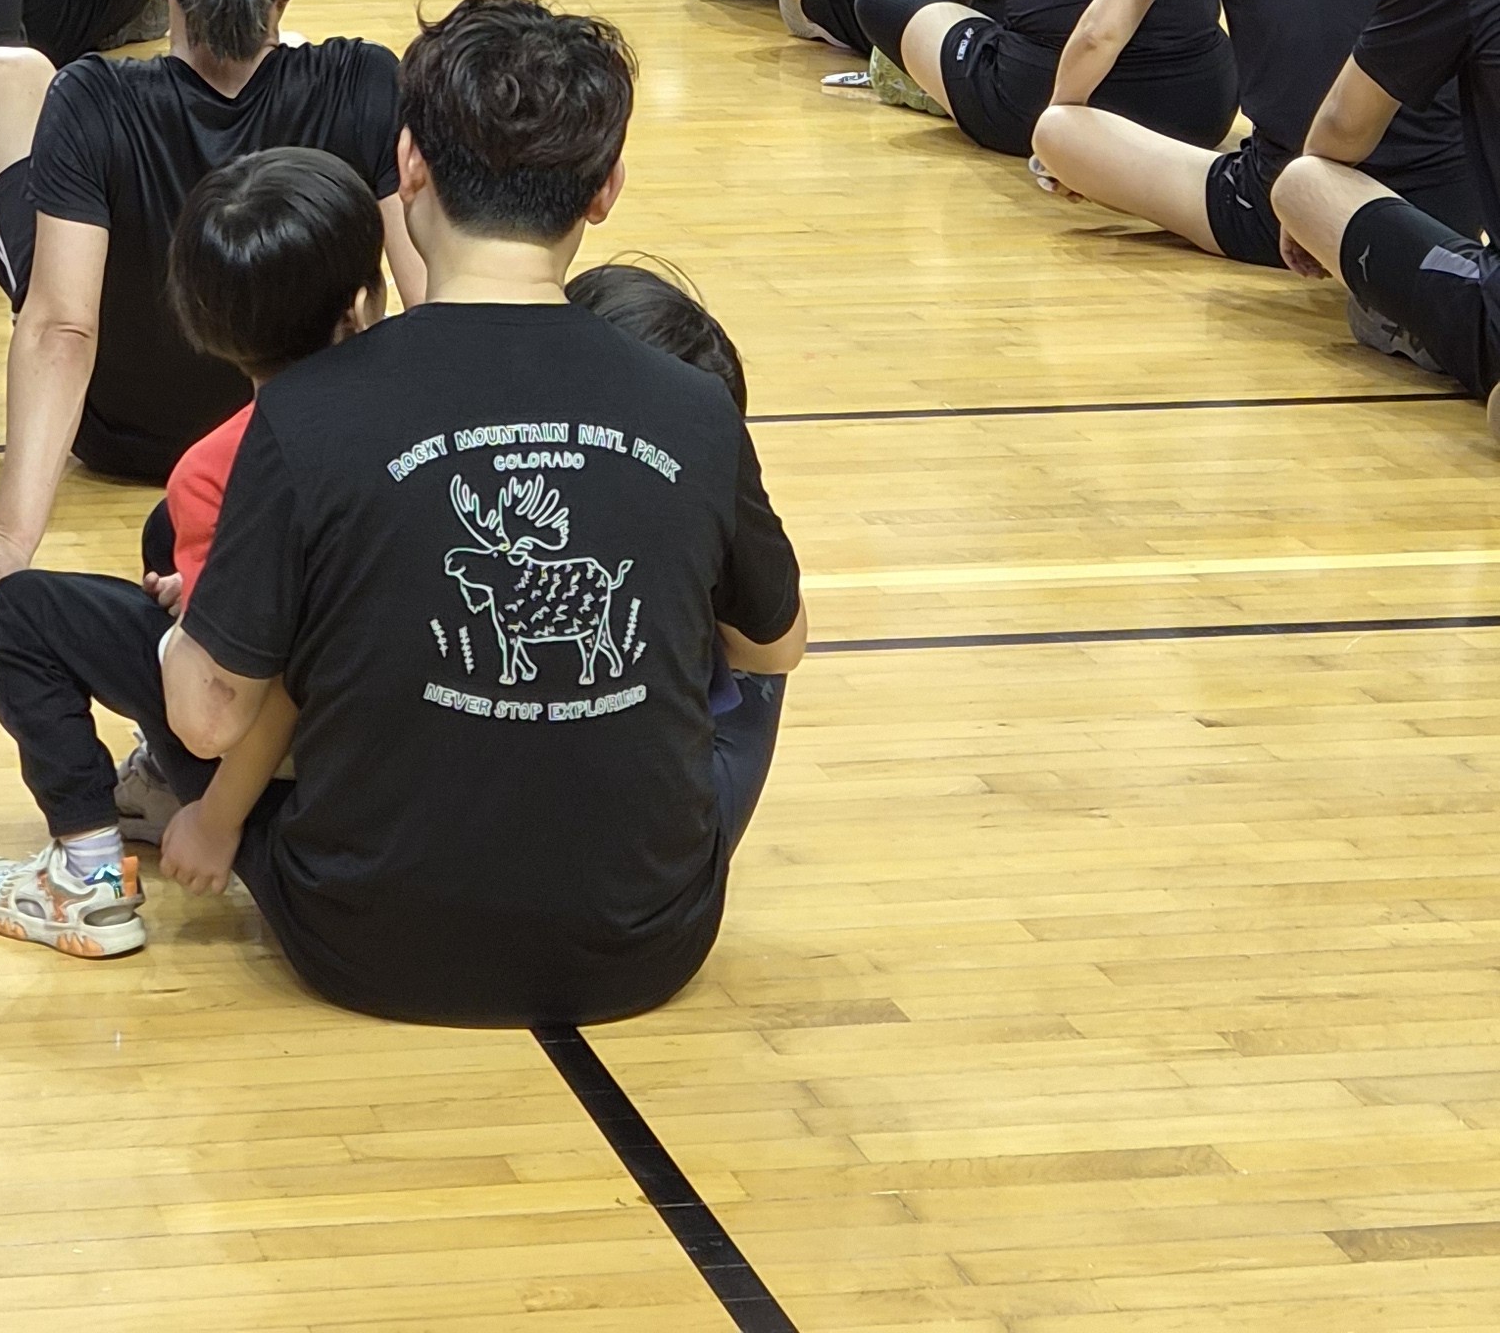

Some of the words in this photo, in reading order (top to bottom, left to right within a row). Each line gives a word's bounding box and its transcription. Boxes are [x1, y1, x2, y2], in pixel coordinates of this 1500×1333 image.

[386, 433, 449, 483] ROCKY
[454, 422, 570, 452] MOUNTAIN
[631, 436, 683, 484] PARK
[493, 450, 585, 471] COLORADO
[422, 682, 493, 717] NEVER
[493, 699, 543, 721] STOP
[547, 684, 647, 721] EXPLORING
